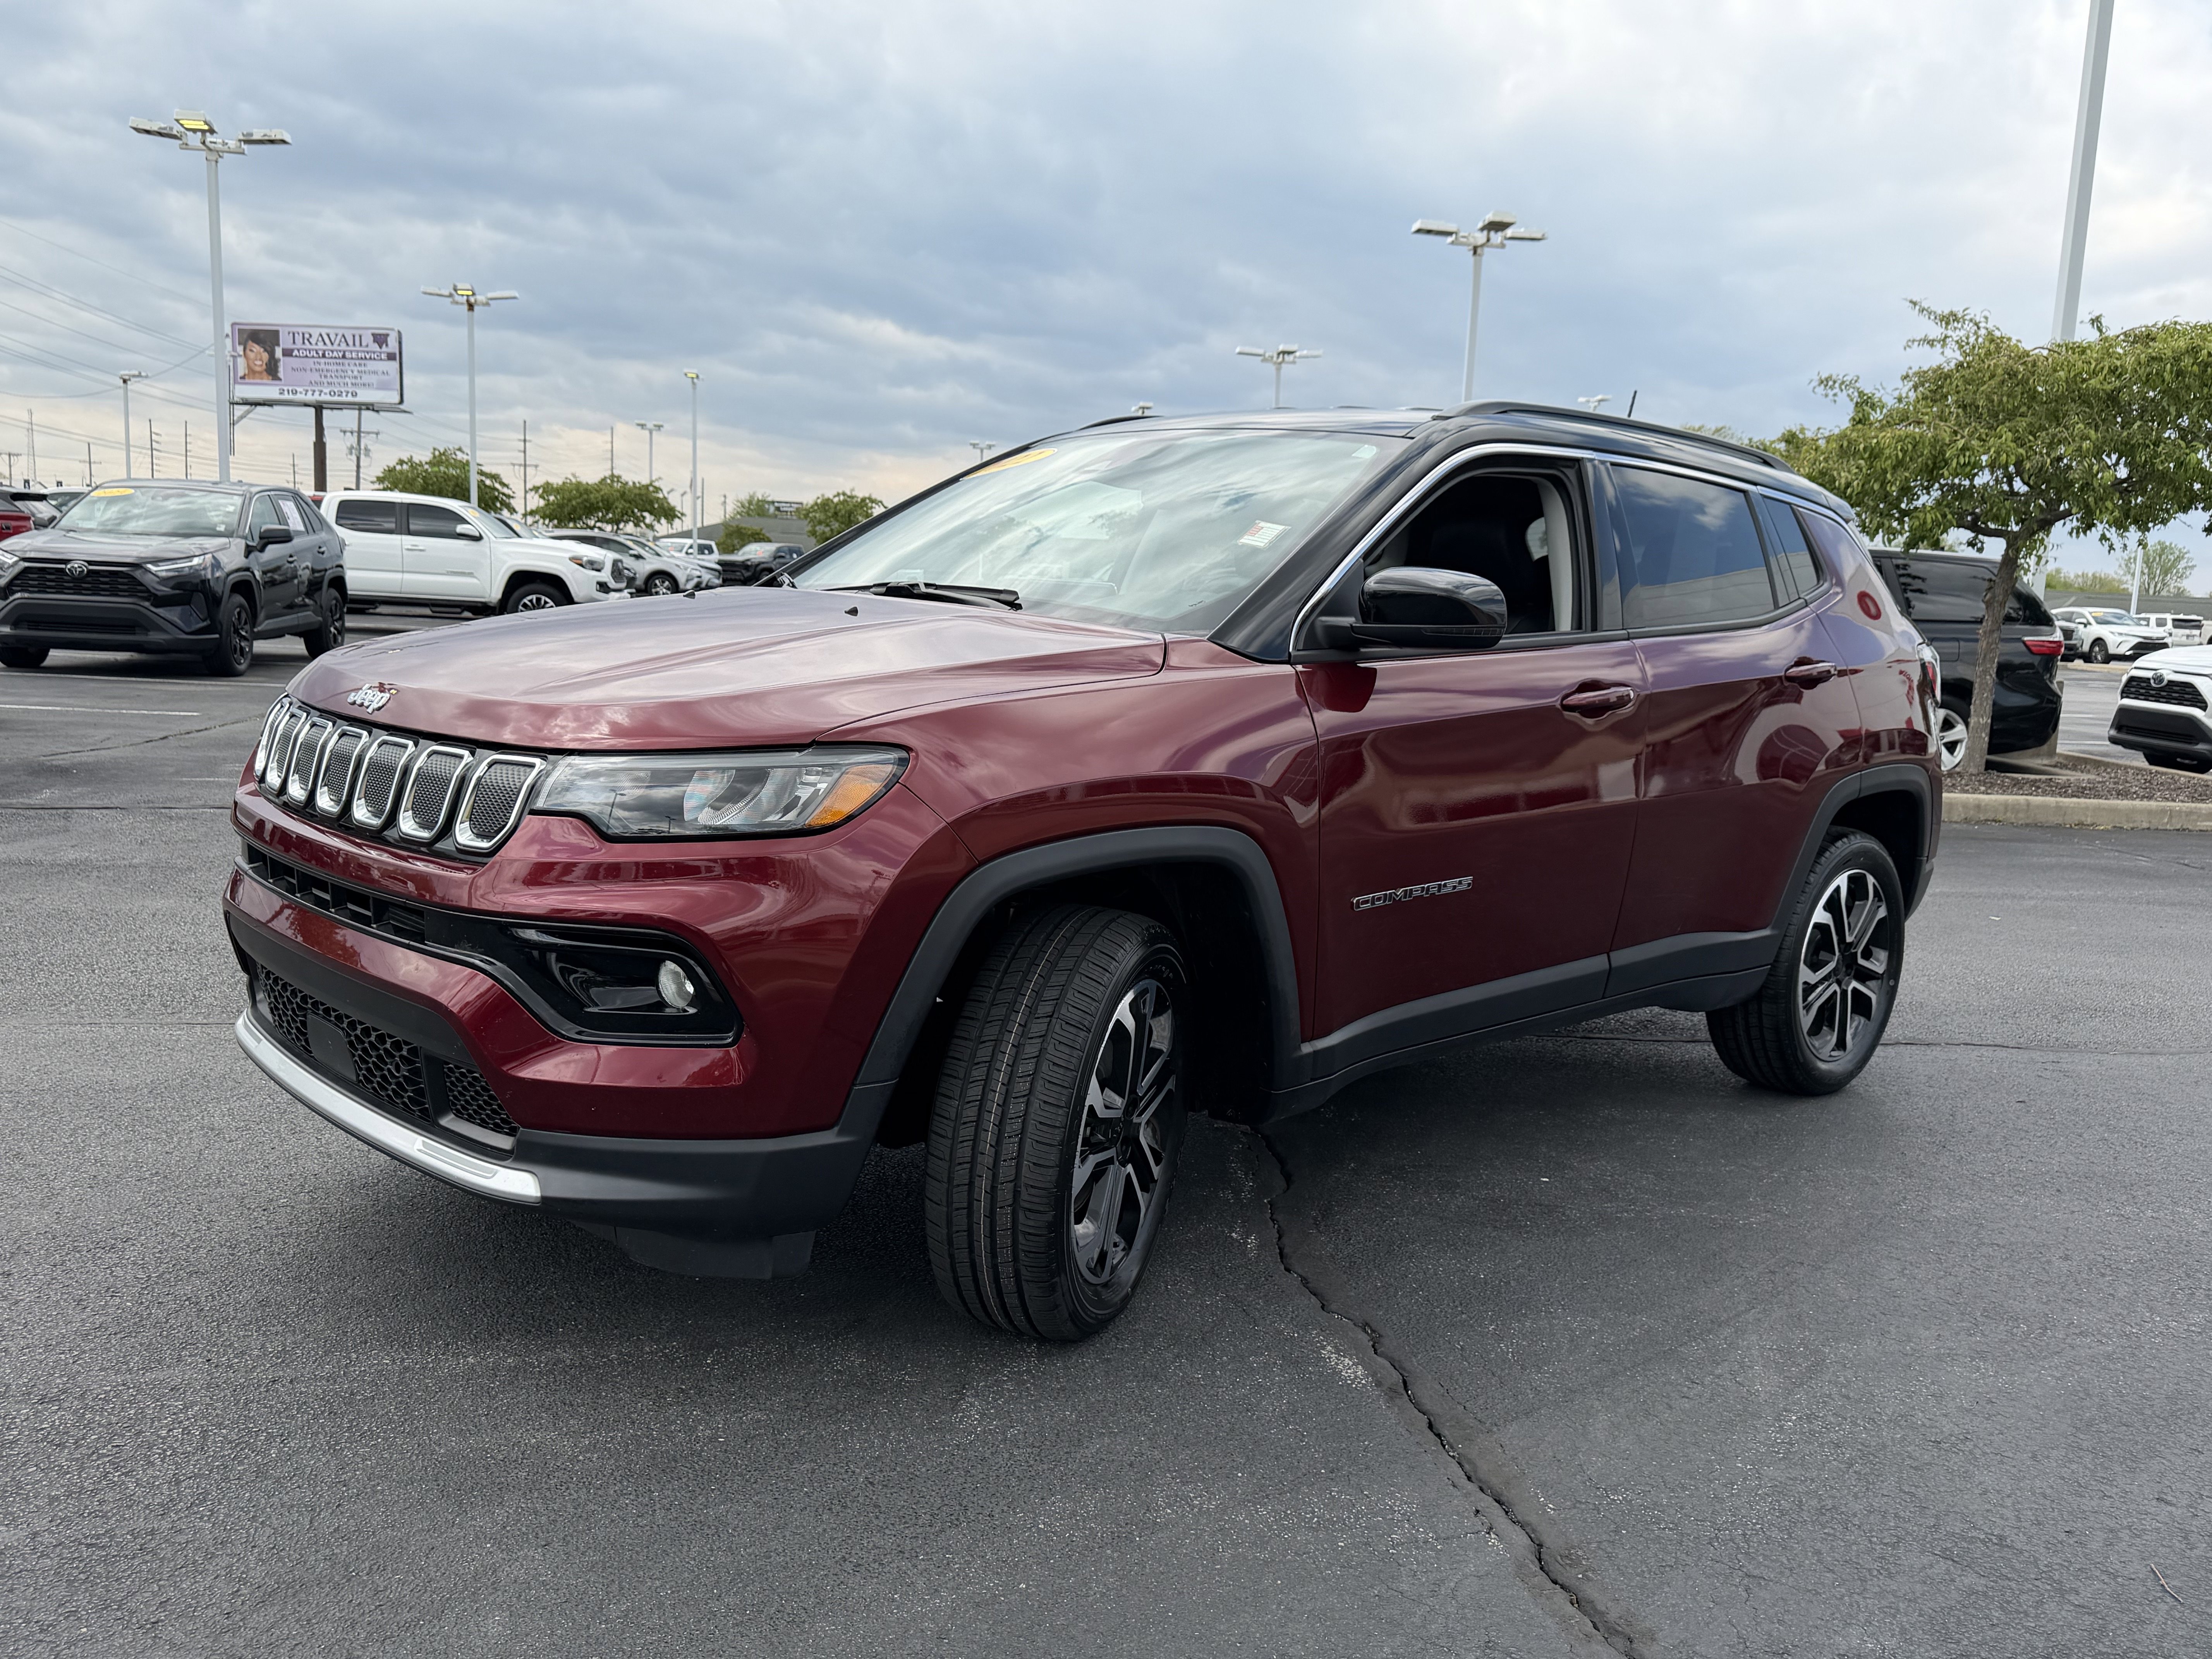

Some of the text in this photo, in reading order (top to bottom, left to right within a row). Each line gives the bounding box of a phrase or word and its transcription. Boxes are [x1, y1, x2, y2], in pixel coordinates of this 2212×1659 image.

[288, 331, 369, 347] TRAVAIL
[292, 349, 388, 360] ADULT DAY SERVICE
[347, 684, 390, 714] Jeep
[1351, 876, 1473, 911] COMPASS
